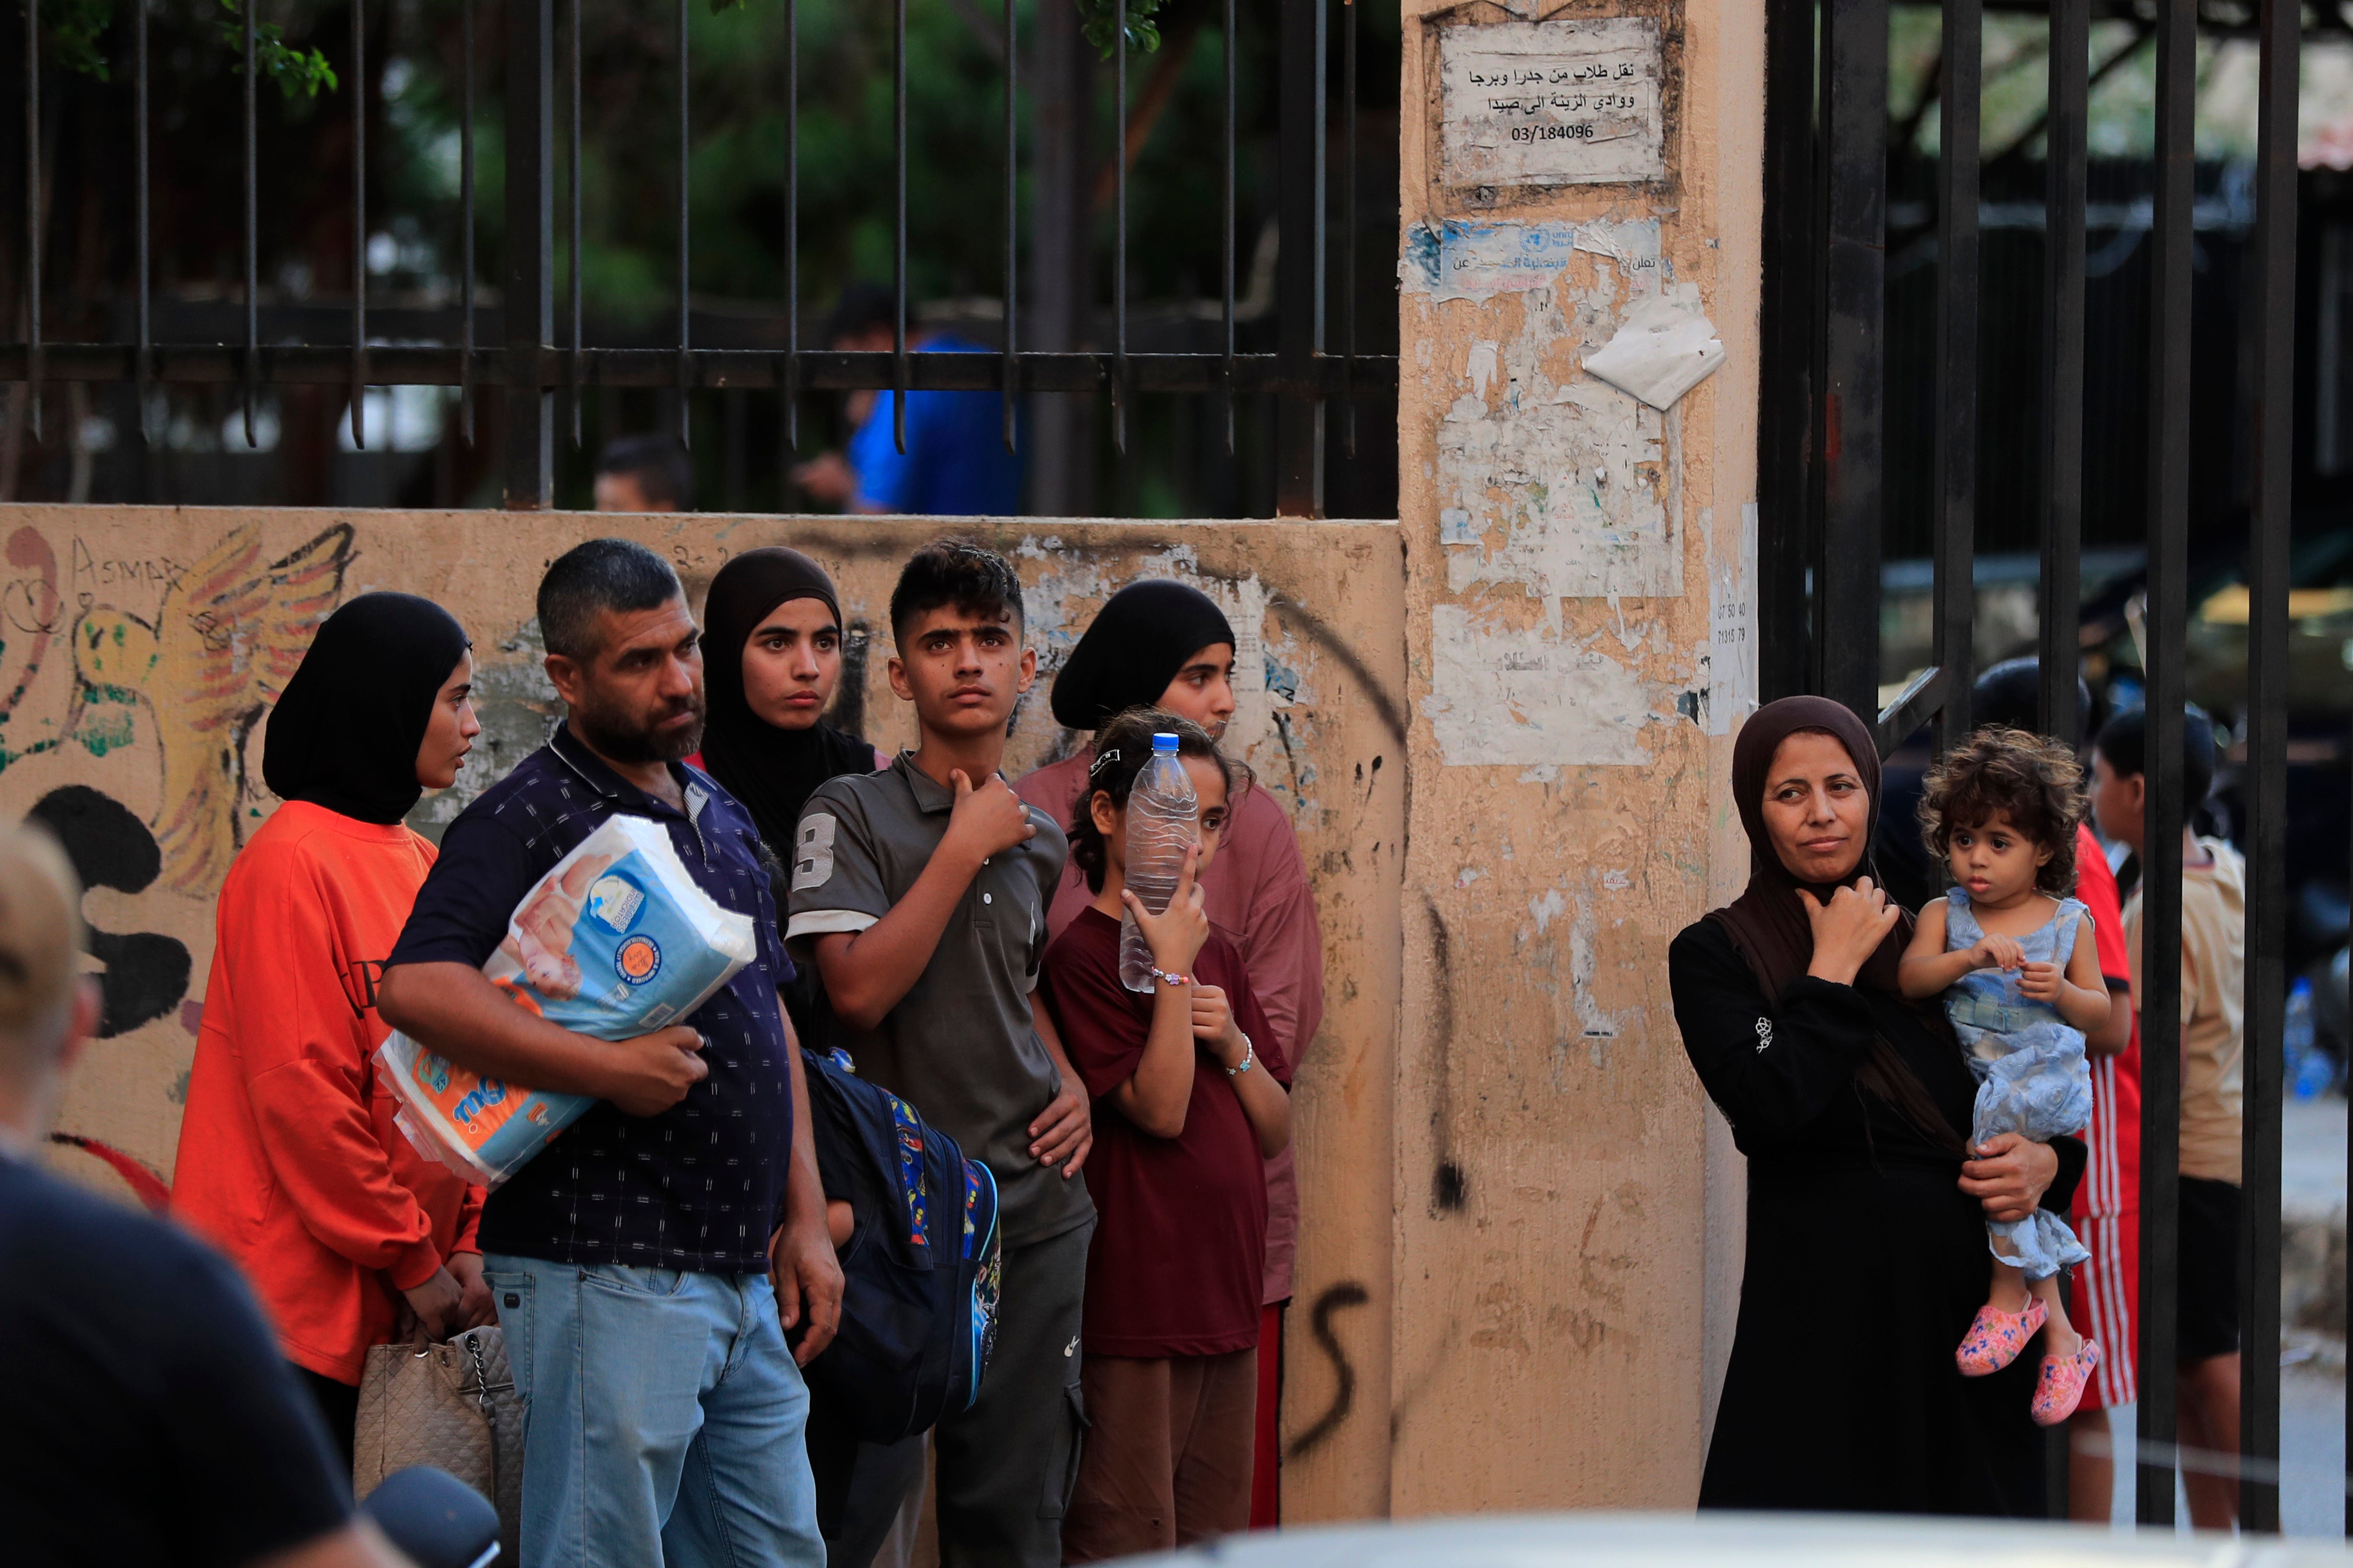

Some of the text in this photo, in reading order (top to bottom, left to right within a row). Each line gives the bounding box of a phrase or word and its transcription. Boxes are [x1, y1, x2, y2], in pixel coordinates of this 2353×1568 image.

[1469, 63, 1634, 86] نقل طلاب من جدرا وبرجا
[1488, 92, 1634, 115] ووادي الزينة الى صيدا
[1511, 125, 1594, 143] 03/184096
[1453, 257, 1469, 271] عن
[1633, 255, 1655, 271] تعلن
[1738, 627, 1745, 641] 79
[610, 888, 637, 929] INDICATOR
[616, 892, 644, 934] WETNESS
[617, 936, 653, 960] DERMATOLOGICALLY
[632, 969, 656, 983] IMPROVED
[435, 1077, 446, 1091] 42
